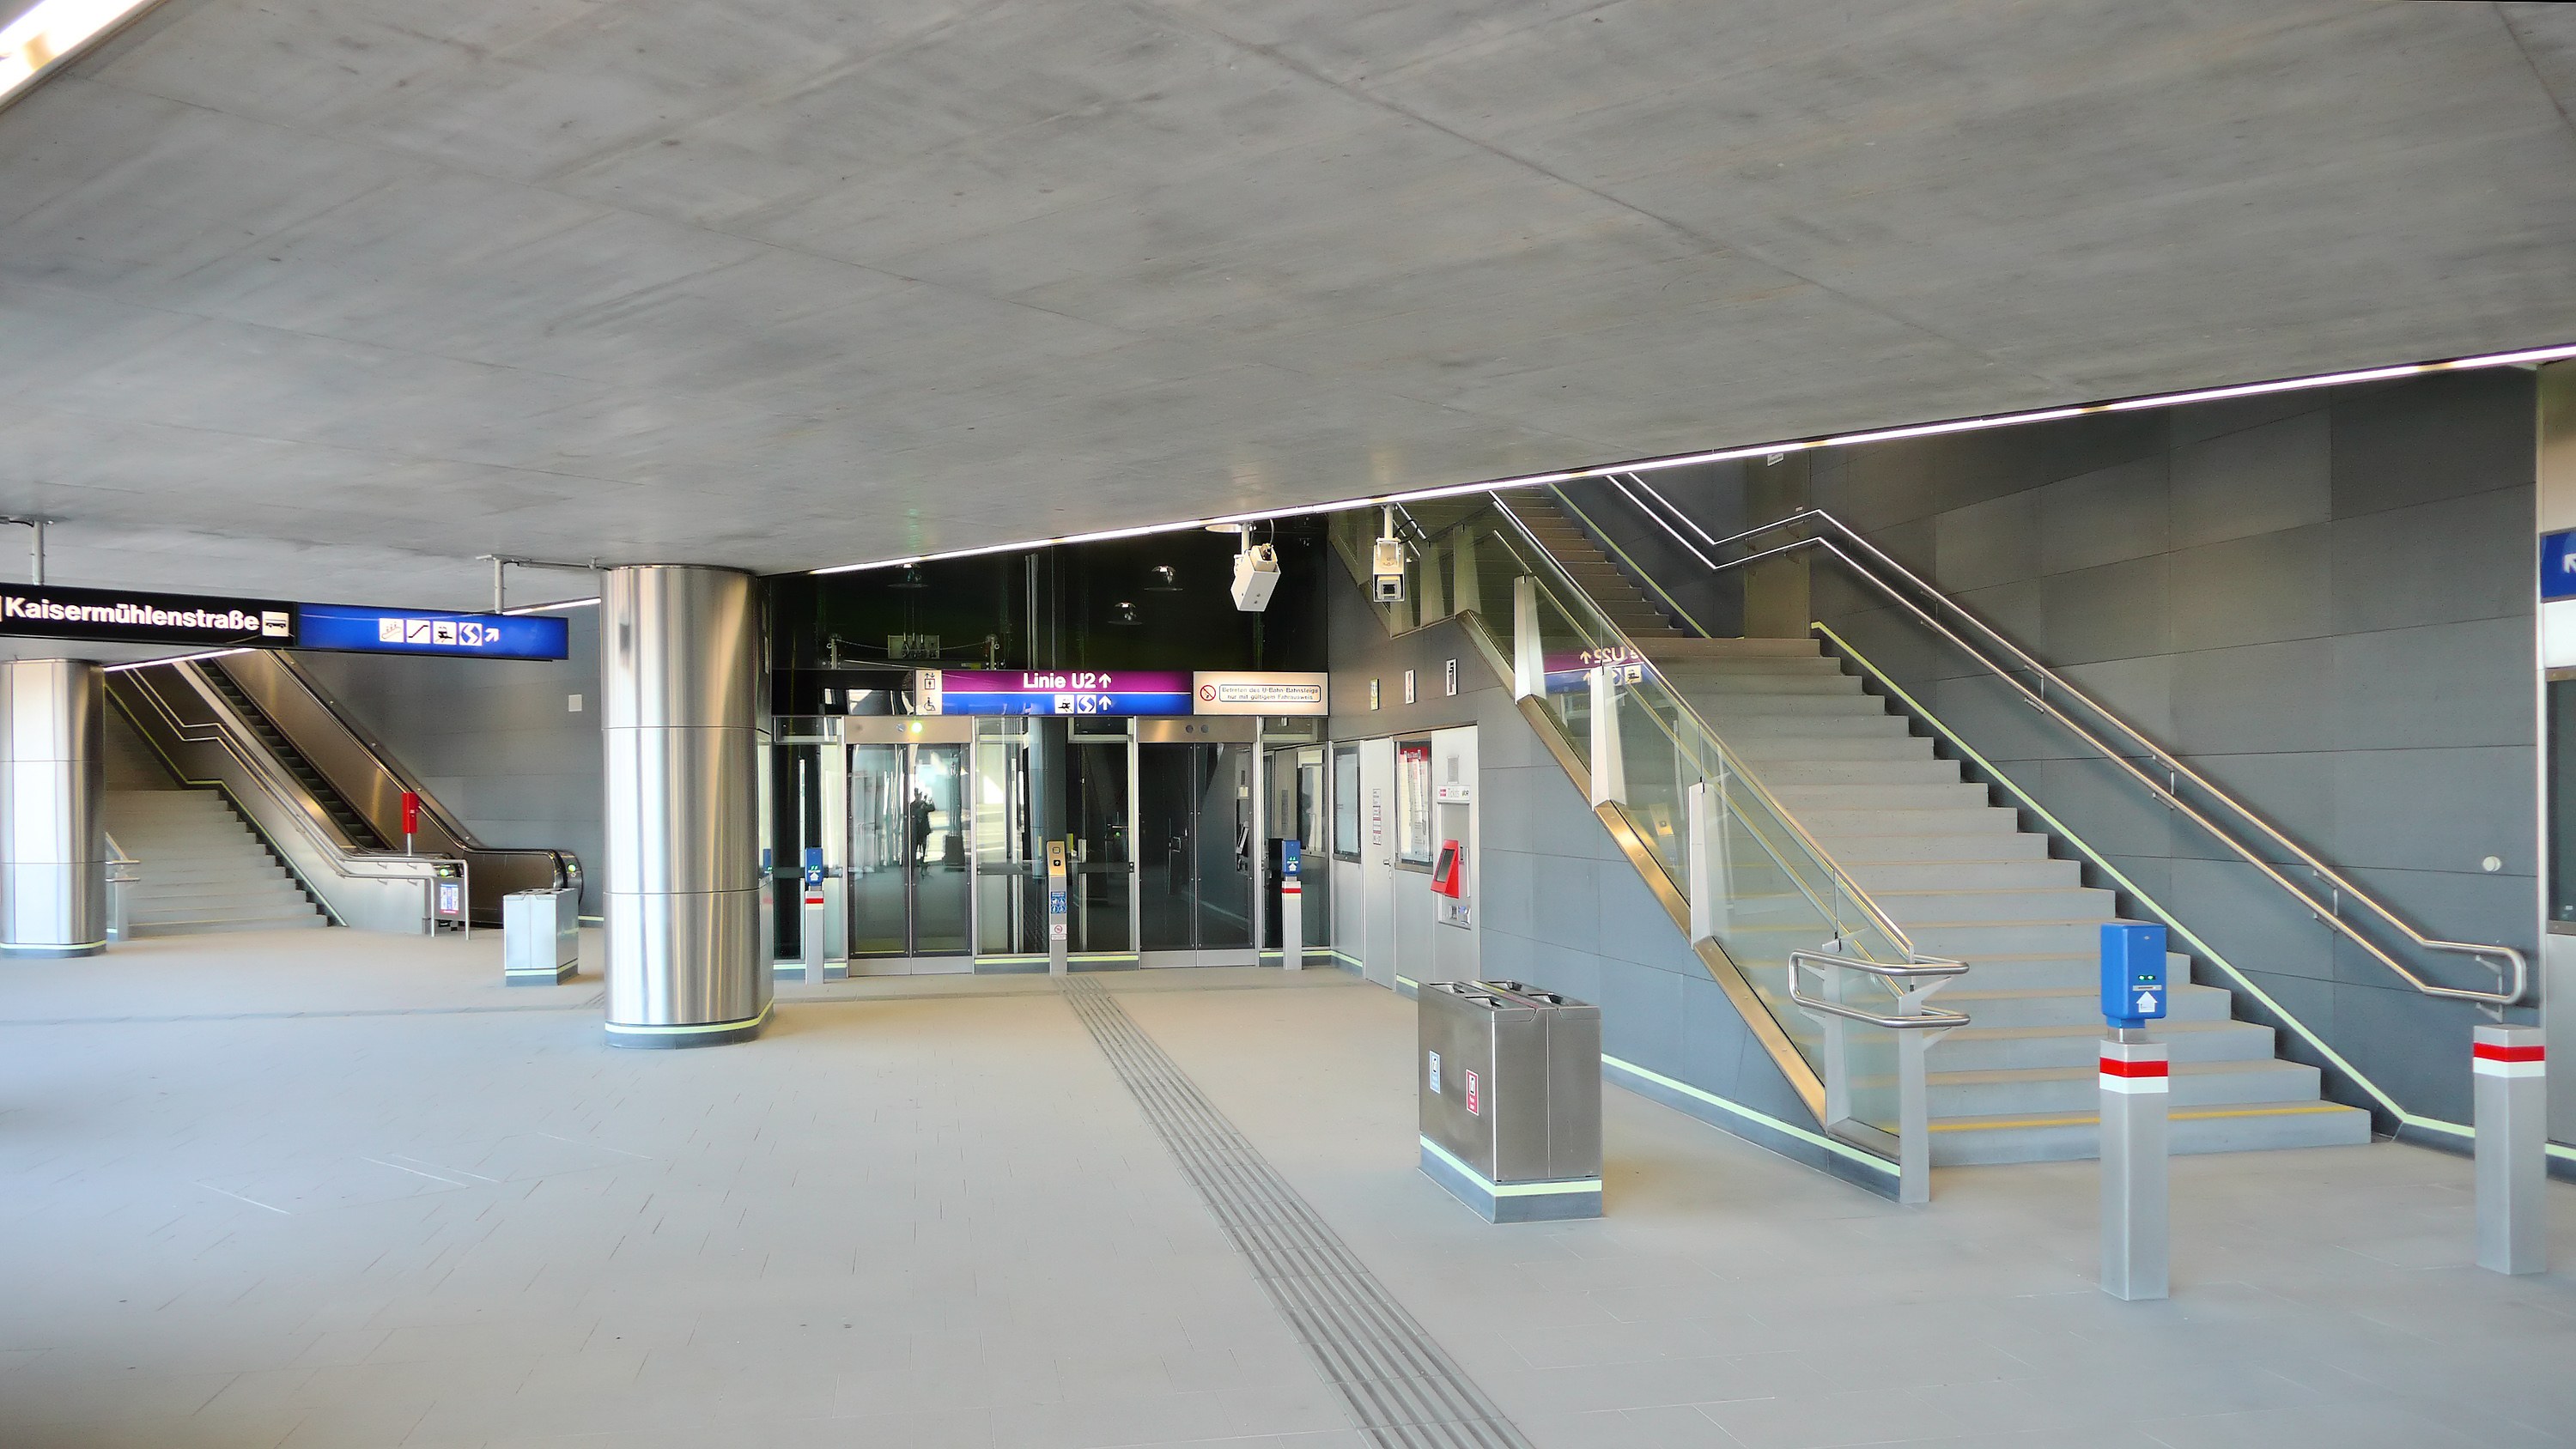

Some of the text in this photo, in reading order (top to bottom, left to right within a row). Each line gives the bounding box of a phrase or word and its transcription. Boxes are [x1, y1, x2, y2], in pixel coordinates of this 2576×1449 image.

[5, 596, 260, 631] Kaisermühlenstraße
[1024, 672, 1097, 688] Linie U2
